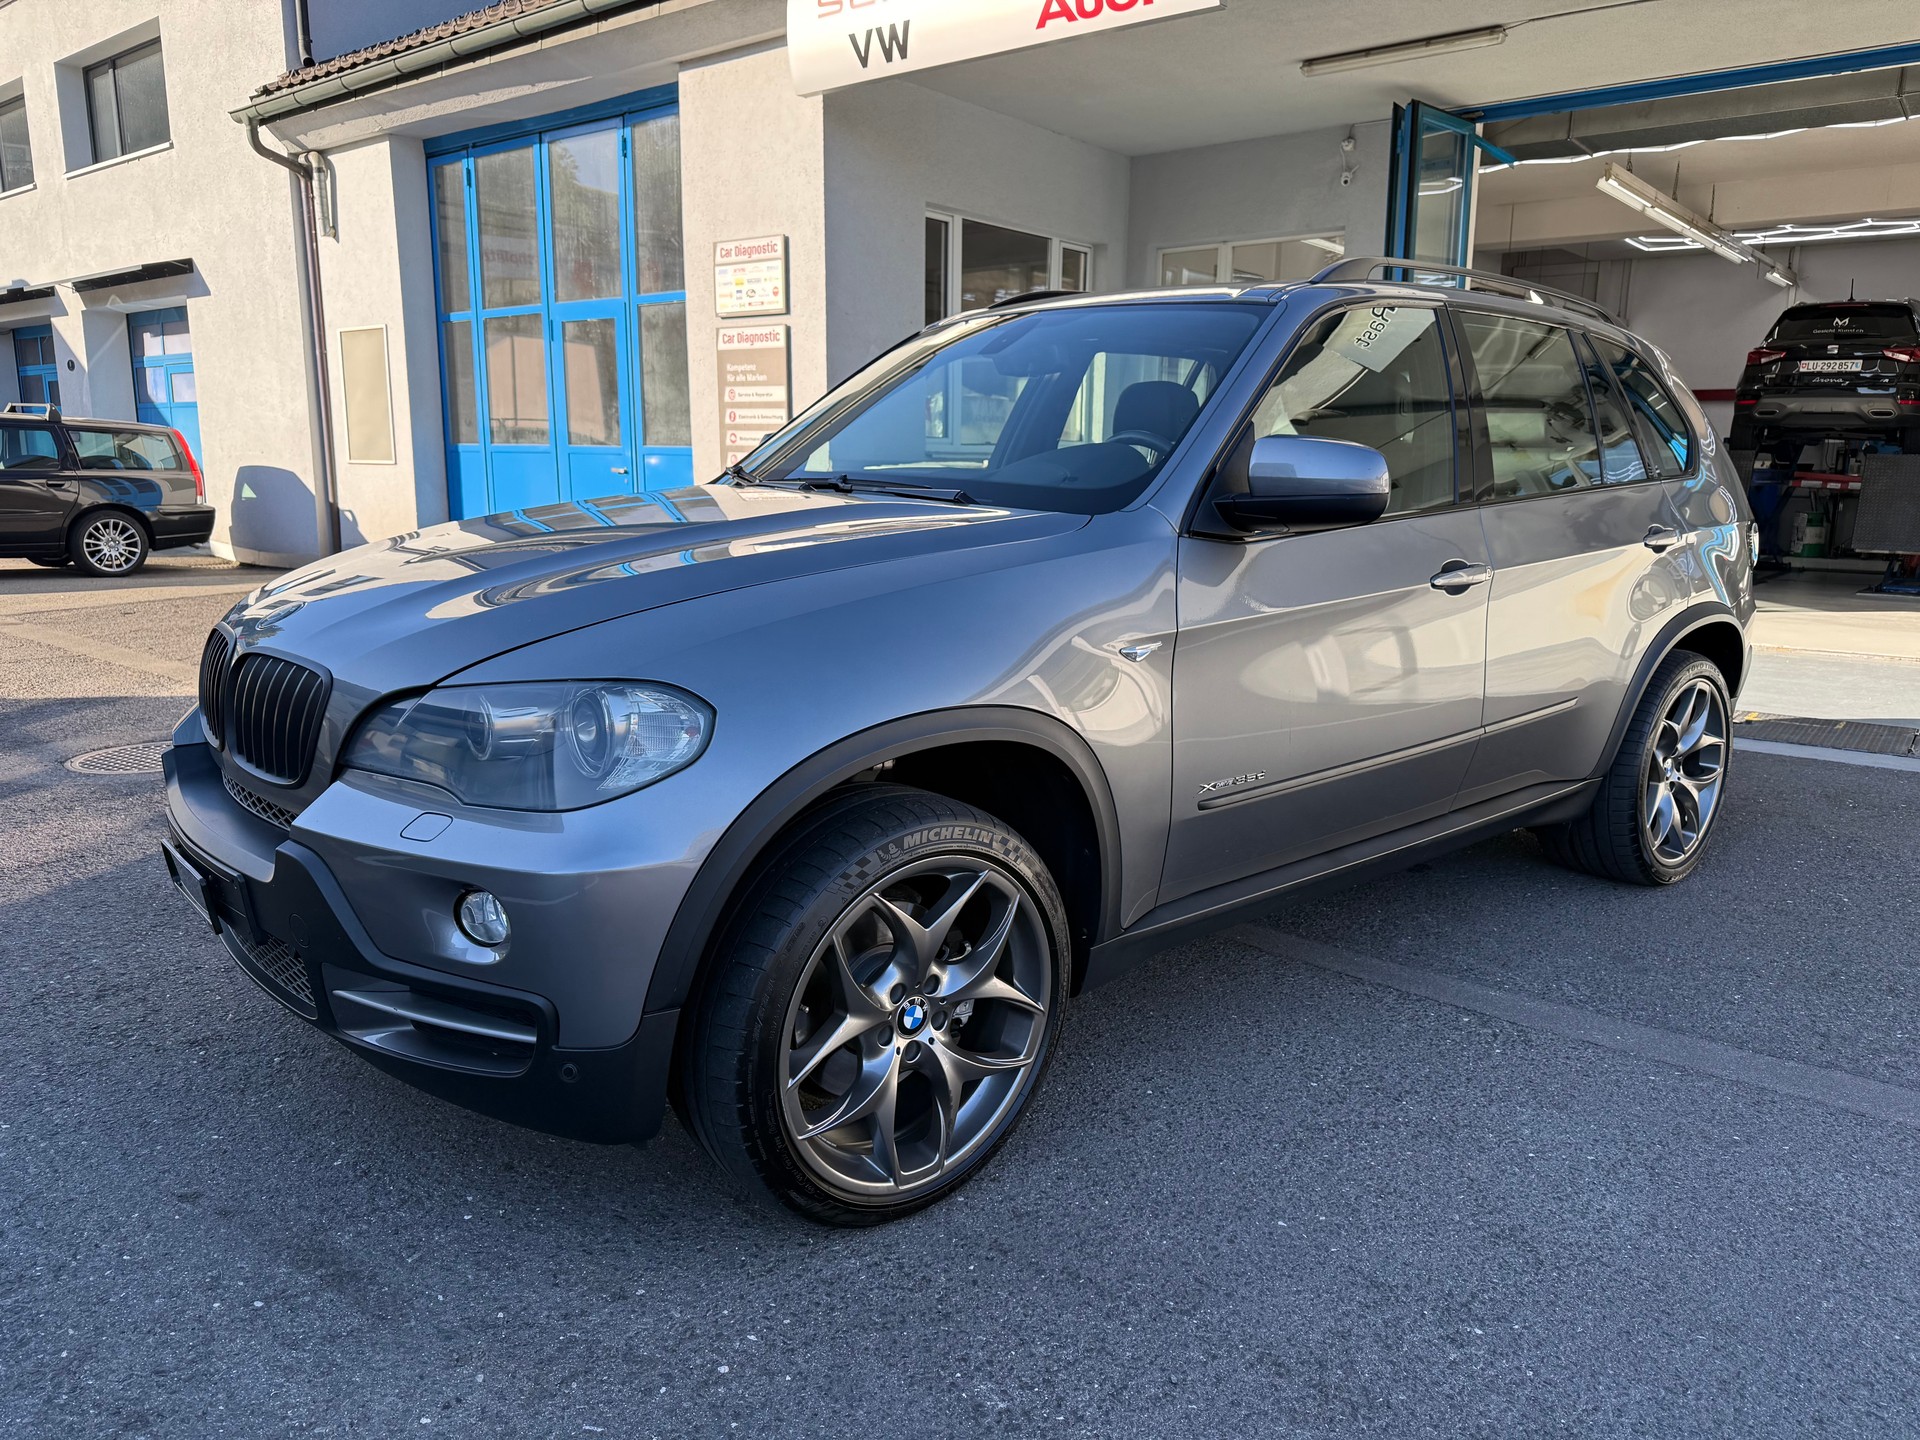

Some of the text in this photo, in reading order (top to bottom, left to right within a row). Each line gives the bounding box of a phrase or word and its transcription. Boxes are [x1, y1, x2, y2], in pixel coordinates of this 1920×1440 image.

[848, 19, 911, 69] VW
[720, 240, 778, 259] Car Diagnostic
[722, 329, 780, 346] Car Diagnostic
[903, 826, 993, 850] MICHELIN
[903, 997, 928, 1012] BMW
